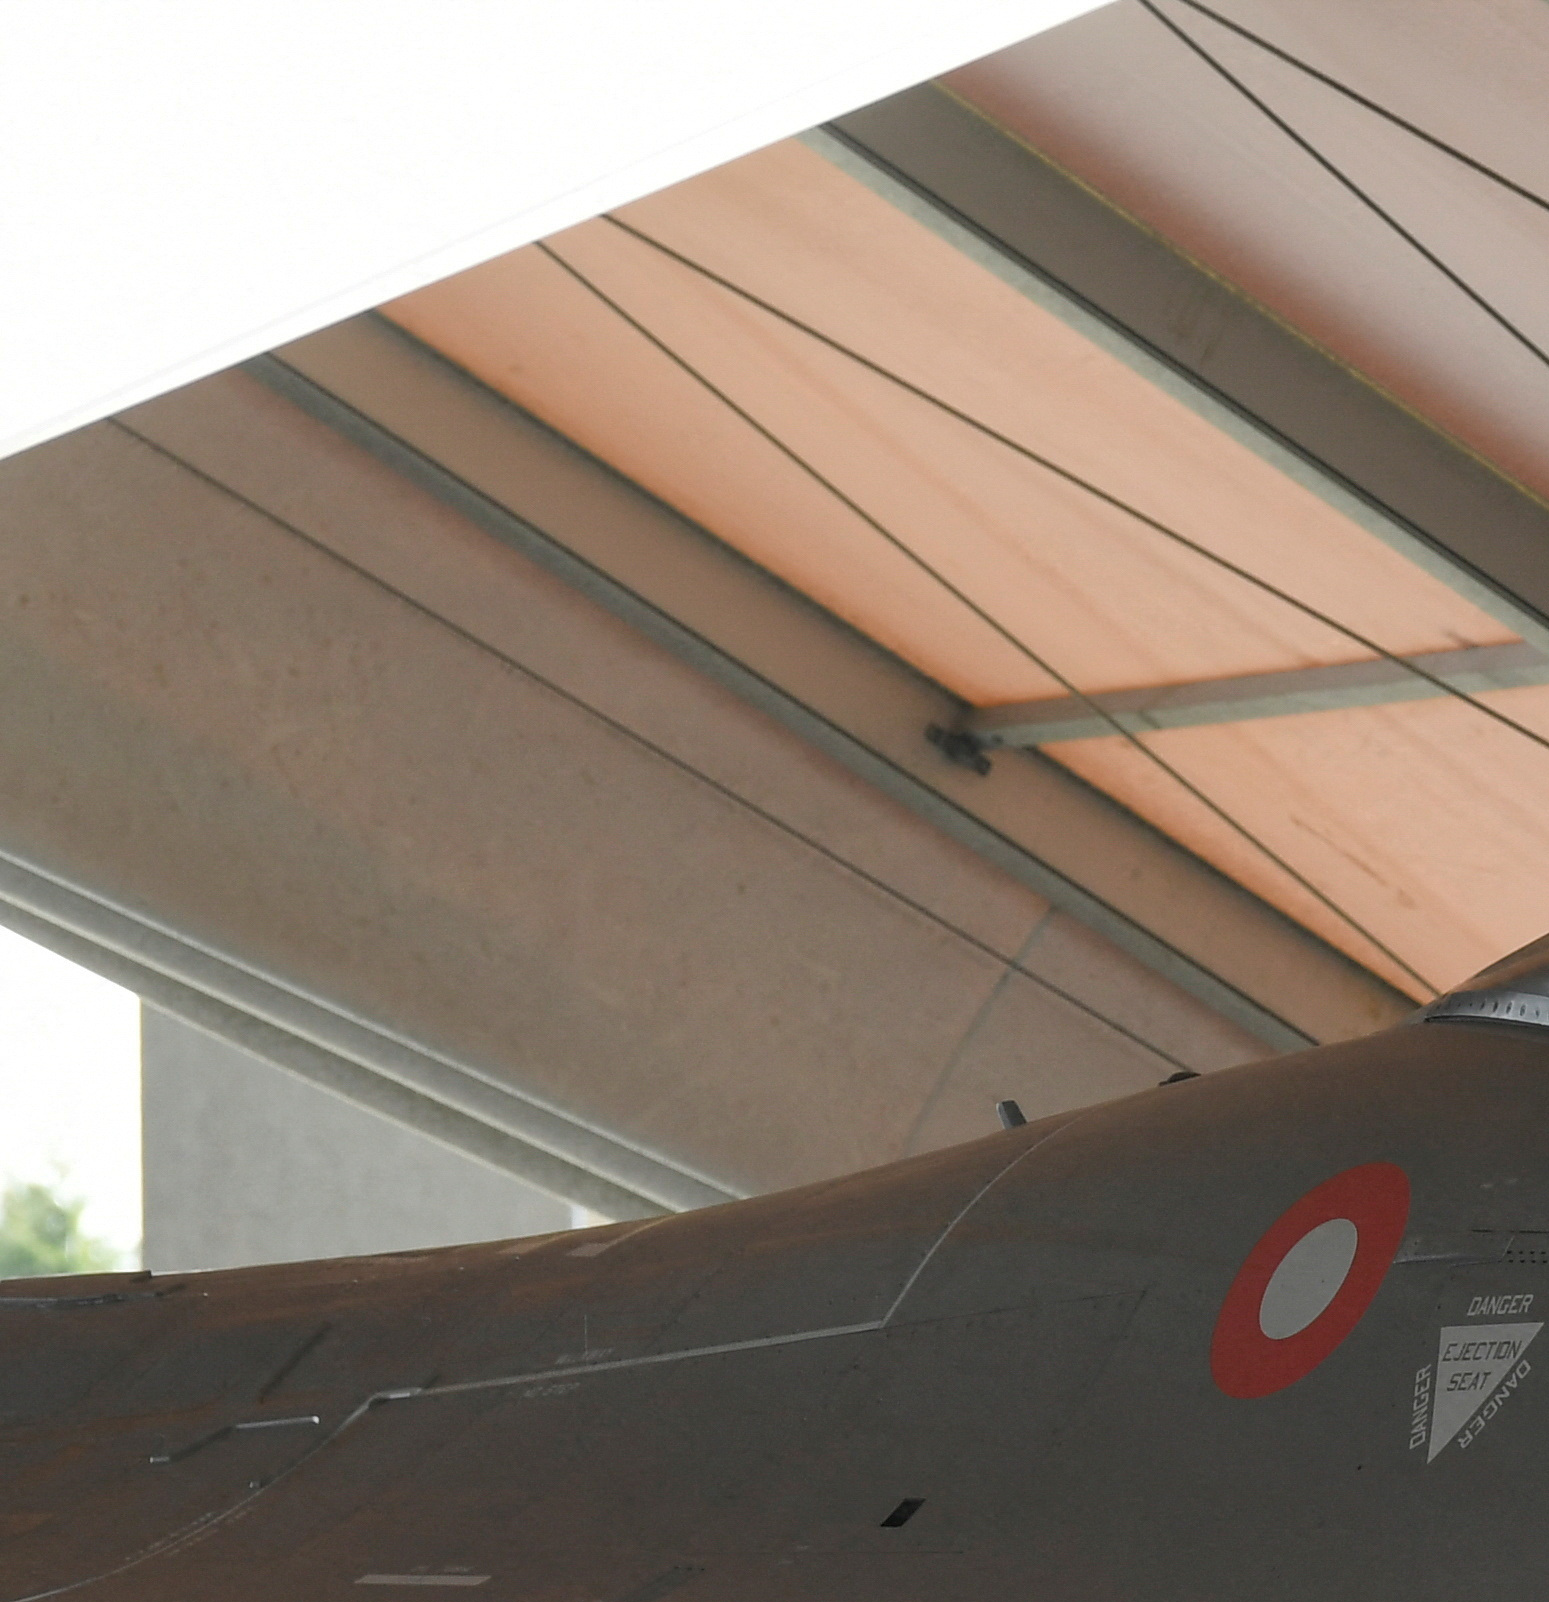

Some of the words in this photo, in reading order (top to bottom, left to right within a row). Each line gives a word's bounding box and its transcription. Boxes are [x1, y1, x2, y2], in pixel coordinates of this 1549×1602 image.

[1466, 1293, 1534, 1316] DANGER
[1442, 1340, 1523, 1362] EJECTION
[1446, 1371, 1492, 1392] SEAT
[1408, 1363, 1432, 1450] DANGER
[1457, 1359, 1532, 1449] DANGER
